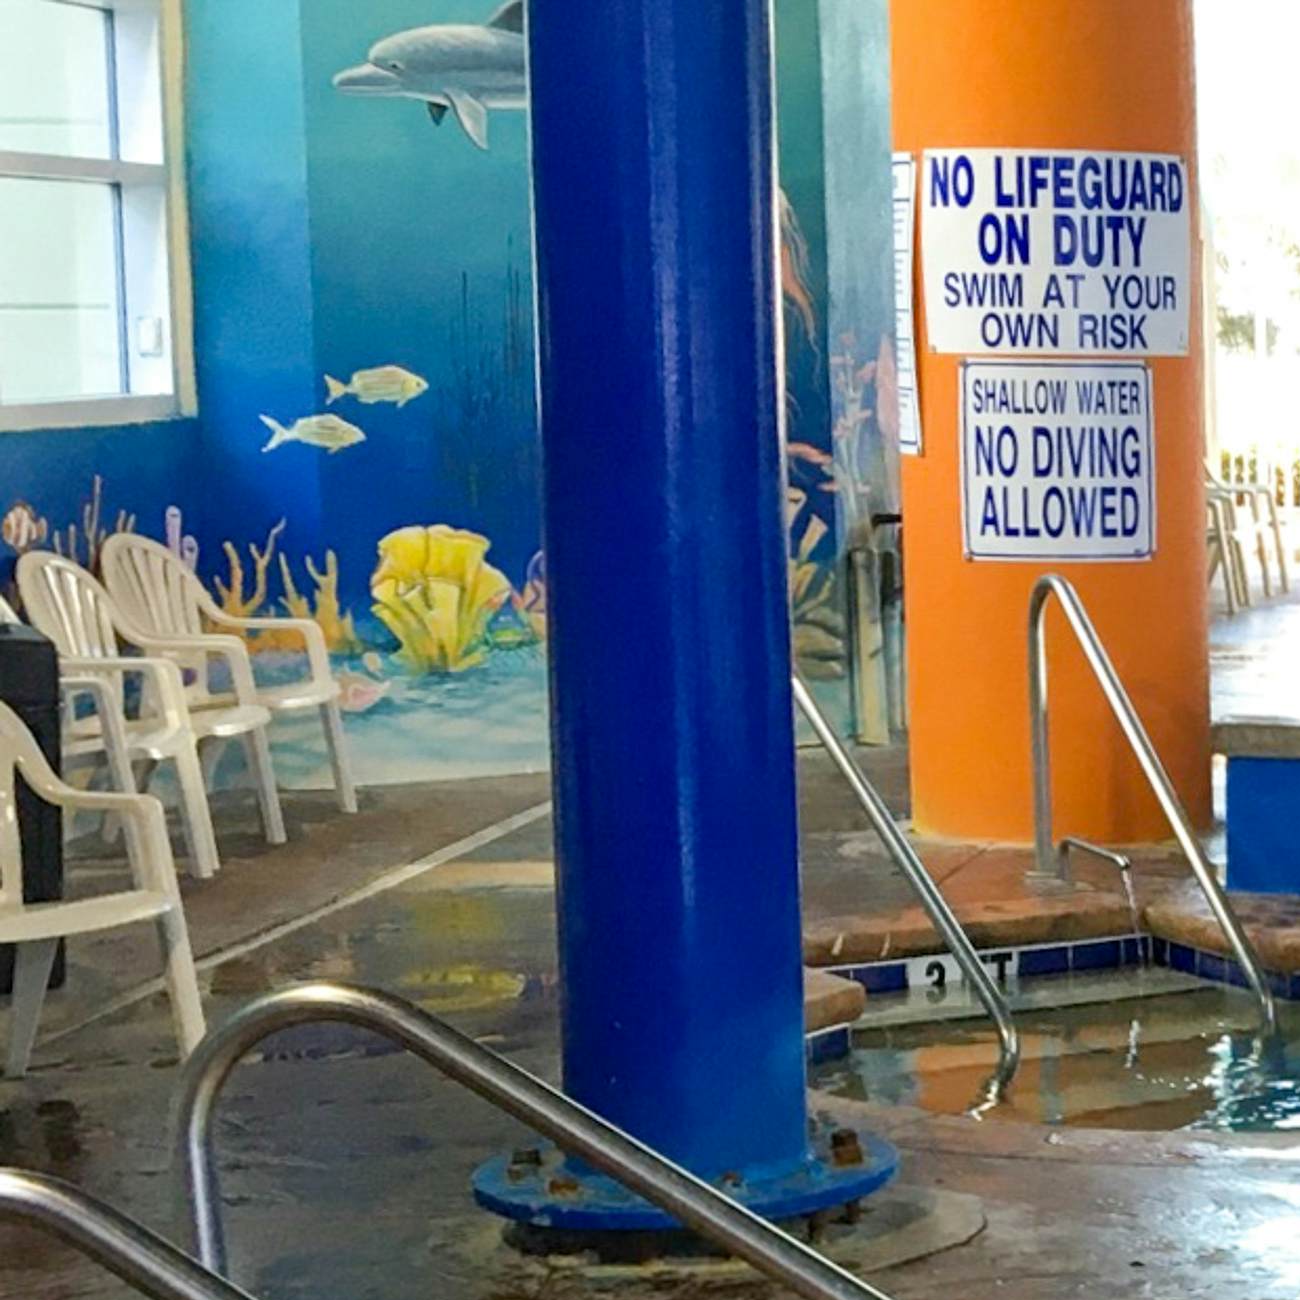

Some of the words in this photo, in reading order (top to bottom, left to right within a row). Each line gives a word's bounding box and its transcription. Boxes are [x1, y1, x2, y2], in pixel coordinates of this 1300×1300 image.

[930, 155, 975, 208] NO
[994, 156, 1184, 213] LIFEGUARD
[978, 213, 1030, 266] ON
[1054, 215, 1146, 268] DUTY
[944, 273, 1023, 308] SWIM
[1043, 274, 1086, 309] AT
[1103, 275, 1177, 311] YOUR
[981, 313, 1059, 349] OWN
[1079, 315, 1149, 350] RISK
[973, 378, 1067, 415] SHALLOW
[1076, 380, 1141, 416] WATER
[975, 425, 1018, 478] NO
[1033, 427, 1141, 479] DIVING
[980, 486, 1140, 538] ALLOWED
